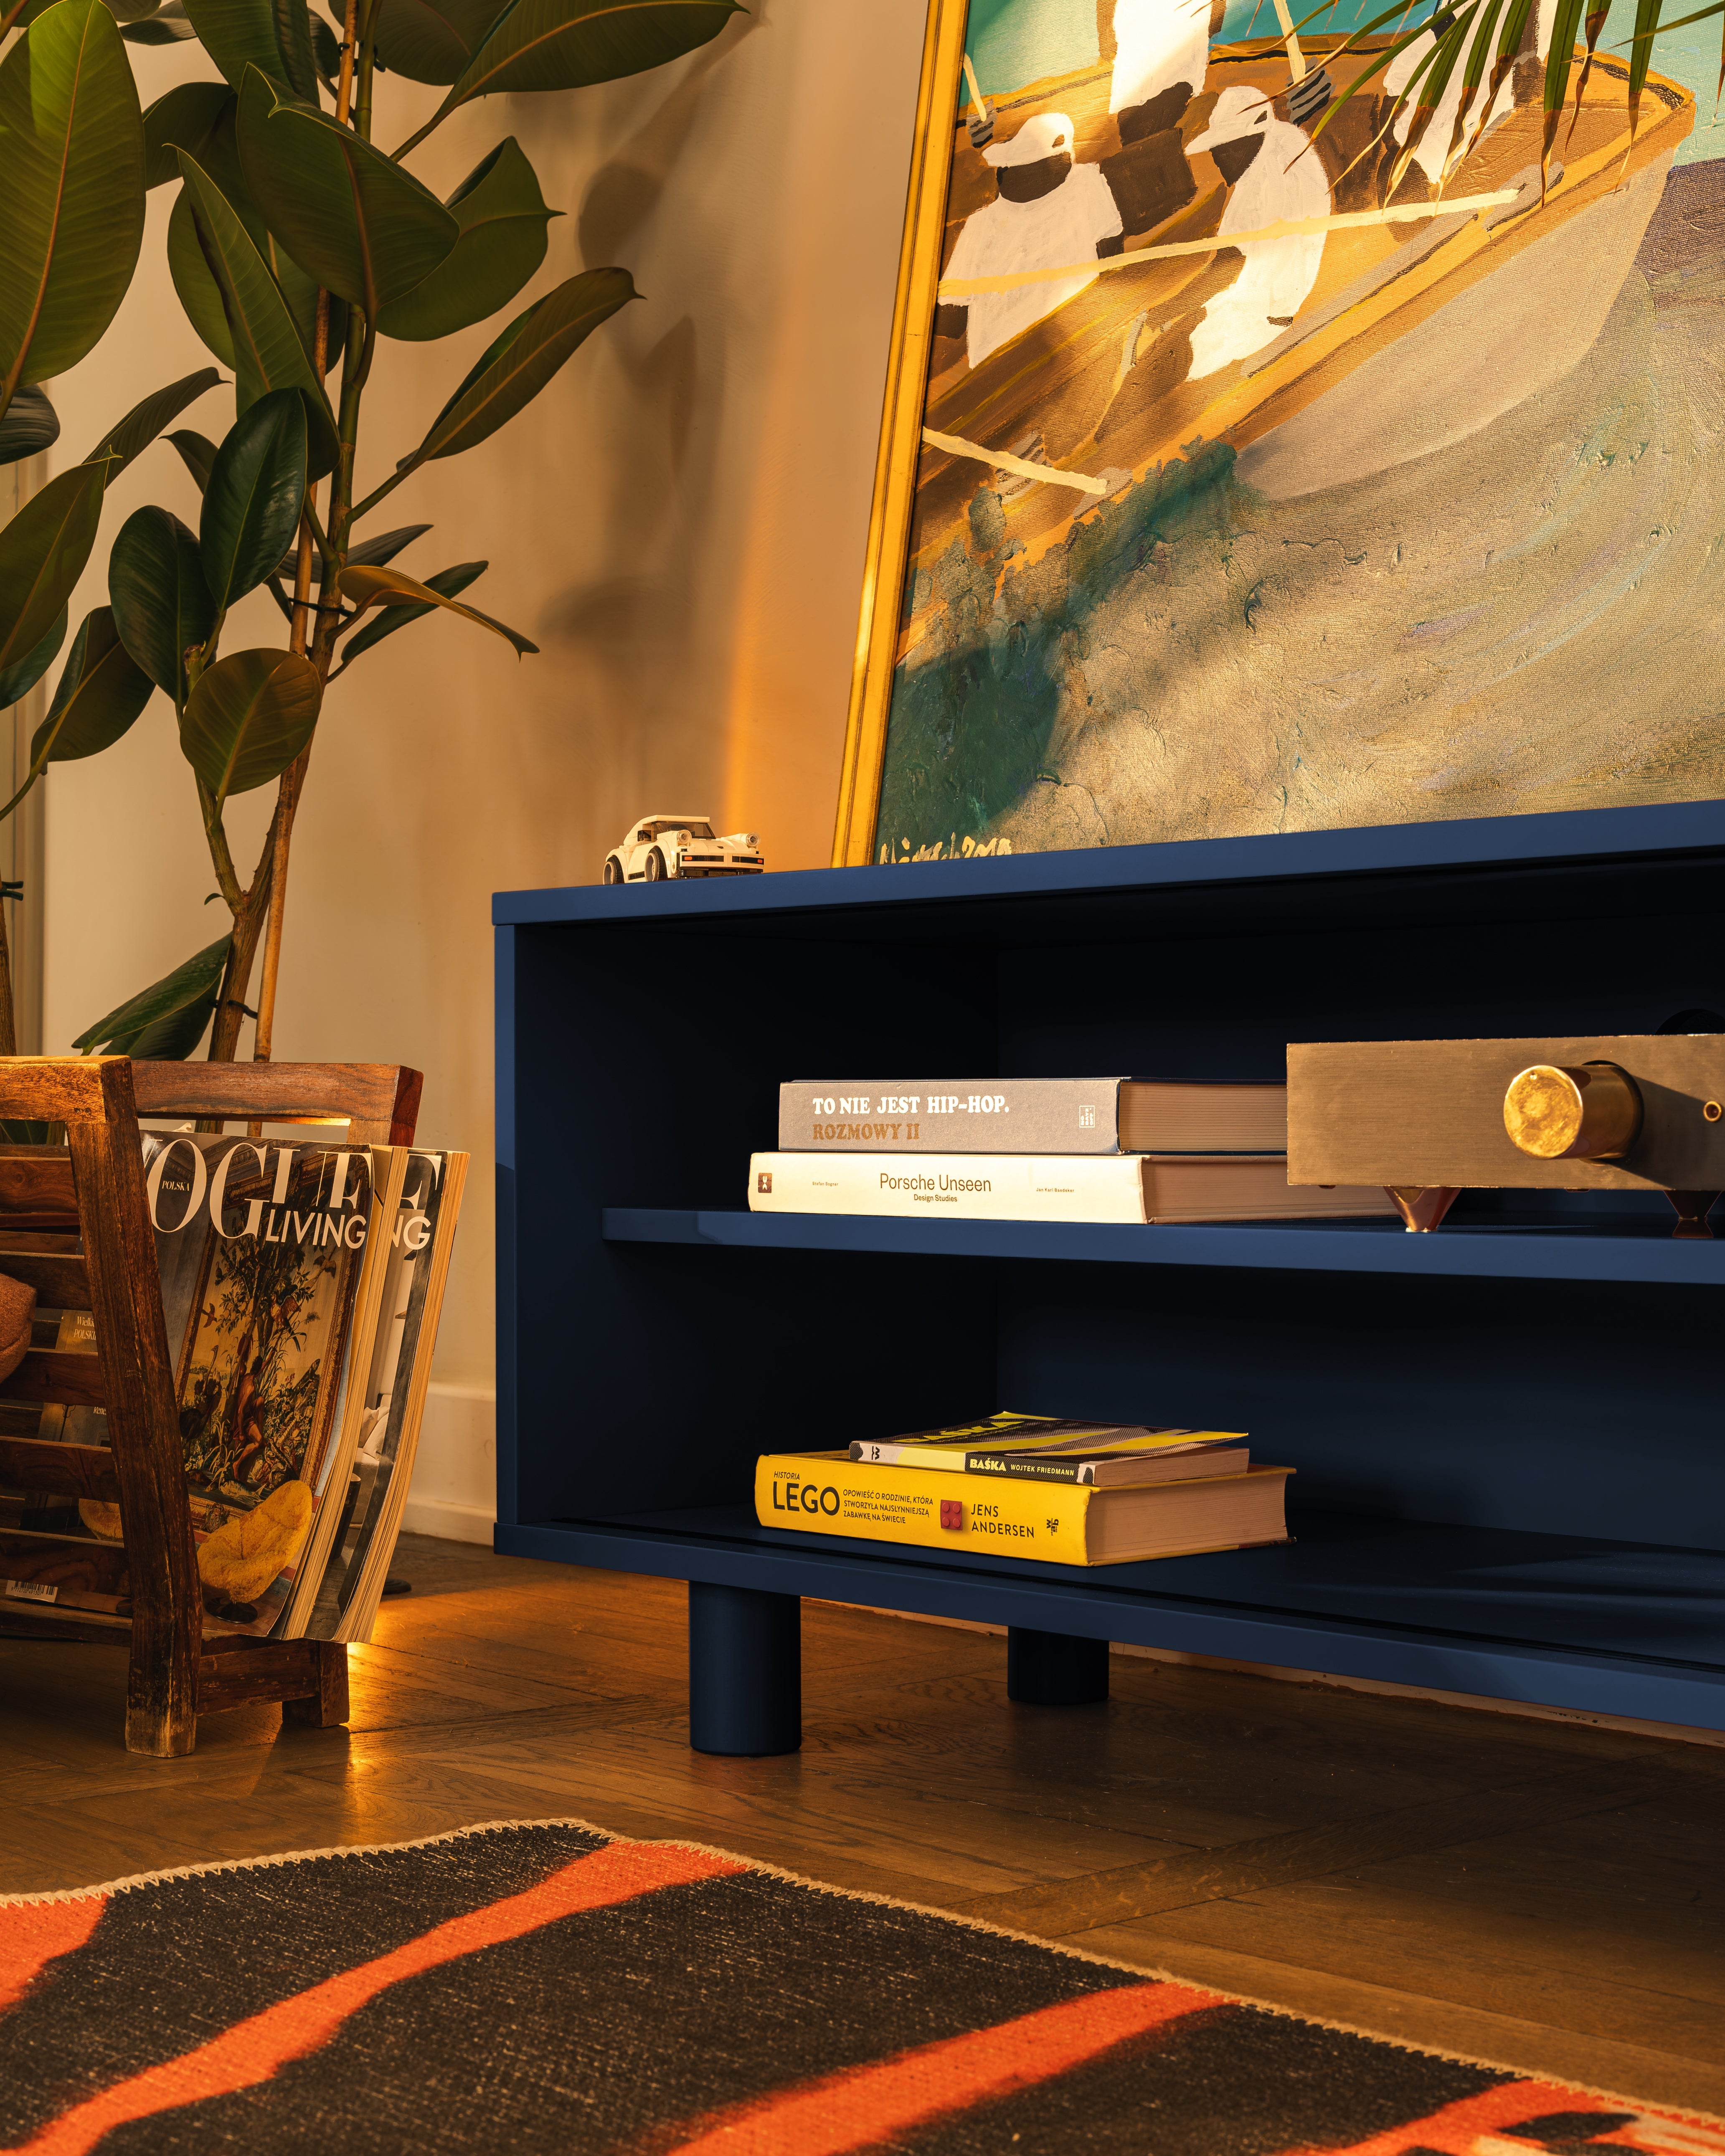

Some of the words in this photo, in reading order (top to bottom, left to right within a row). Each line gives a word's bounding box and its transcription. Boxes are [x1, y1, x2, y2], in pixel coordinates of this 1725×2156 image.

[812, 1097, 836, 1114] TO
[839, 1097, 870, 1114] NIE
[877, 1096, 921, 1114] JEST
[927, 1096, 1010, 1114] HIP-HOP.
[812, 1123, 902, 1140] ROZMOWY
[906, 1123, 920, 1140] II
[162, 1180, 190, 1191] POLSKA
[880, 1173, 935, 1190] Porsche
[939, 1174, 991, 1192] Unseen
[913, 1194, 934, 1202] Design
[266, 1209, 366, 1249] LIVING
[774, 1471, 800, 1480] HISTORIA
[969, 1458, 1007, 1472] BAŚKA
[1010, 1464, 1035, 1472] WOJTEK
[1037, 1466, 1074, 1476] FRIEDMANN
[773, 1481, 840, 1516] LEGO
[843, 1489, 874, 1499] OPOWIEŚĆ
[881, 1493, 912, 1504] RODZINIE,
[913, 1496, 934, 1505] KTÓRA
[843, 1510, 872, 1522] ZABAWKĘ
[882, 1513, 906, 1524] ŚWIECIE
[844, 1500, 878, 1510] STWORZYŁA
[880, 1504, 930, 1518] NAJSŁYNNIEJSZĄ
[971, 1504, 999, 1517] JENS
[971, 1520, 1035, 1538] ANDERSEN
